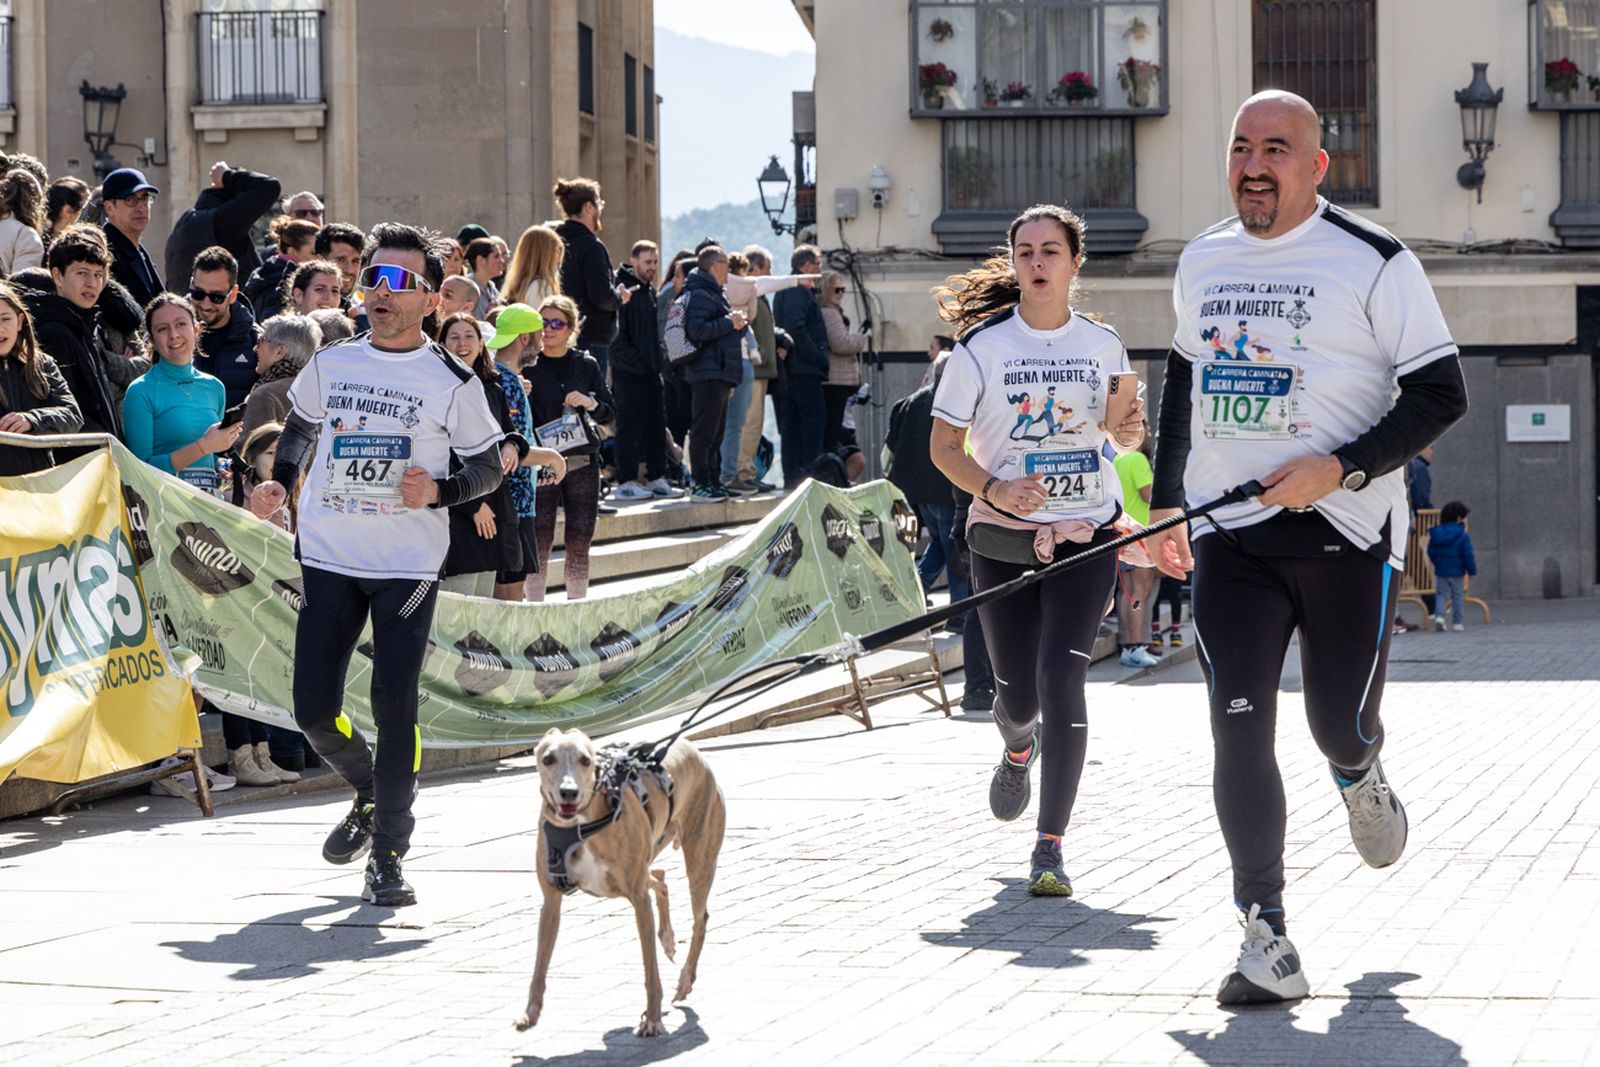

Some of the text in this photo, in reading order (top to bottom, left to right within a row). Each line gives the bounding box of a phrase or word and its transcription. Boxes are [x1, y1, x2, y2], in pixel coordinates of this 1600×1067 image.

[1212, 283, 1255, 295] CARRERA
[1258, 283, 1315, 297] CAMINATA
[1201, 299, 1286, 318] BUENA MUERTE
[1014, 359, 1056, 367] CARRERA
[1058, 358, 1100, 369] CAMINATA
[1004, 370, 1086, 385] BUENA MUERTE
[1217, 368, 1247, 377] CARRERA
[1208, 379, 1266, 392] BUENA MUERTE
[337, 382, 375, 395] CARRERA
[377, 387, 424, 407] CAMINATA
[327, 395, 400, 418] BUENA MUERTE
[1212, 395, 1271, 424] 1107
[372, 437, 402, 445] CAMINATA
[339, 446, 388, 456] BUENA MUERTE
[346, 459, 393, 482] 467
[1034, 462, 1081, 474] BUENA MUERTE
[1044, 474, 1085, 497] 224
